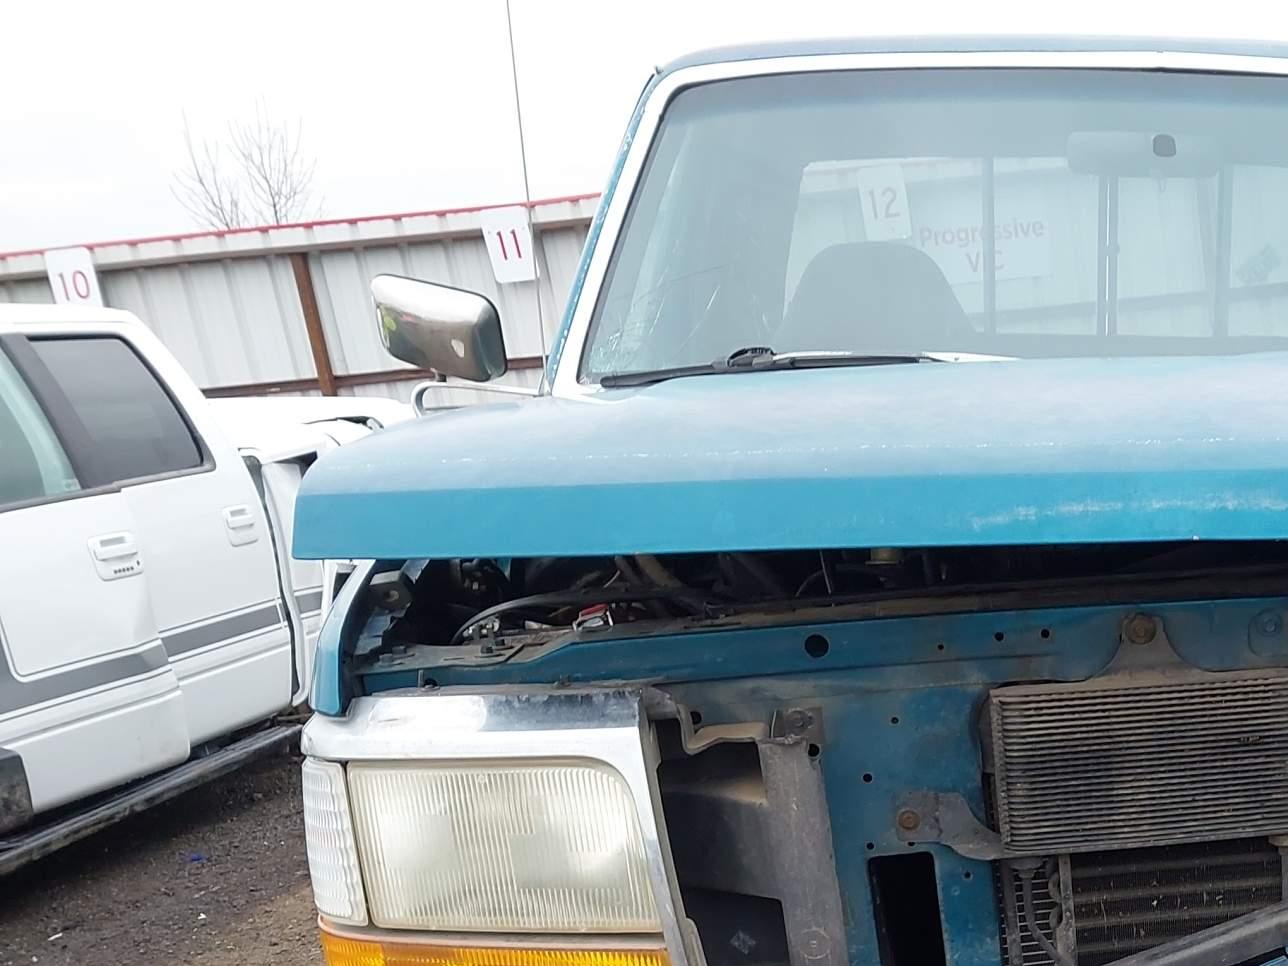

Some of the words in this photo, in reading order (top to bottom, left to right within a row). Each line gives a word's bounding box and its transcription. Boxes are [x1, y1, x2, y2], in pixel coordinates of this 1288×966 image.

[867, 187, 901, 221] 12
[495, 229, 523, 261] 11
[919, 217, 1044, 248] Progrssive
[965, 249, 1005, 273] VC
[58, 270, 91, 302] 10
